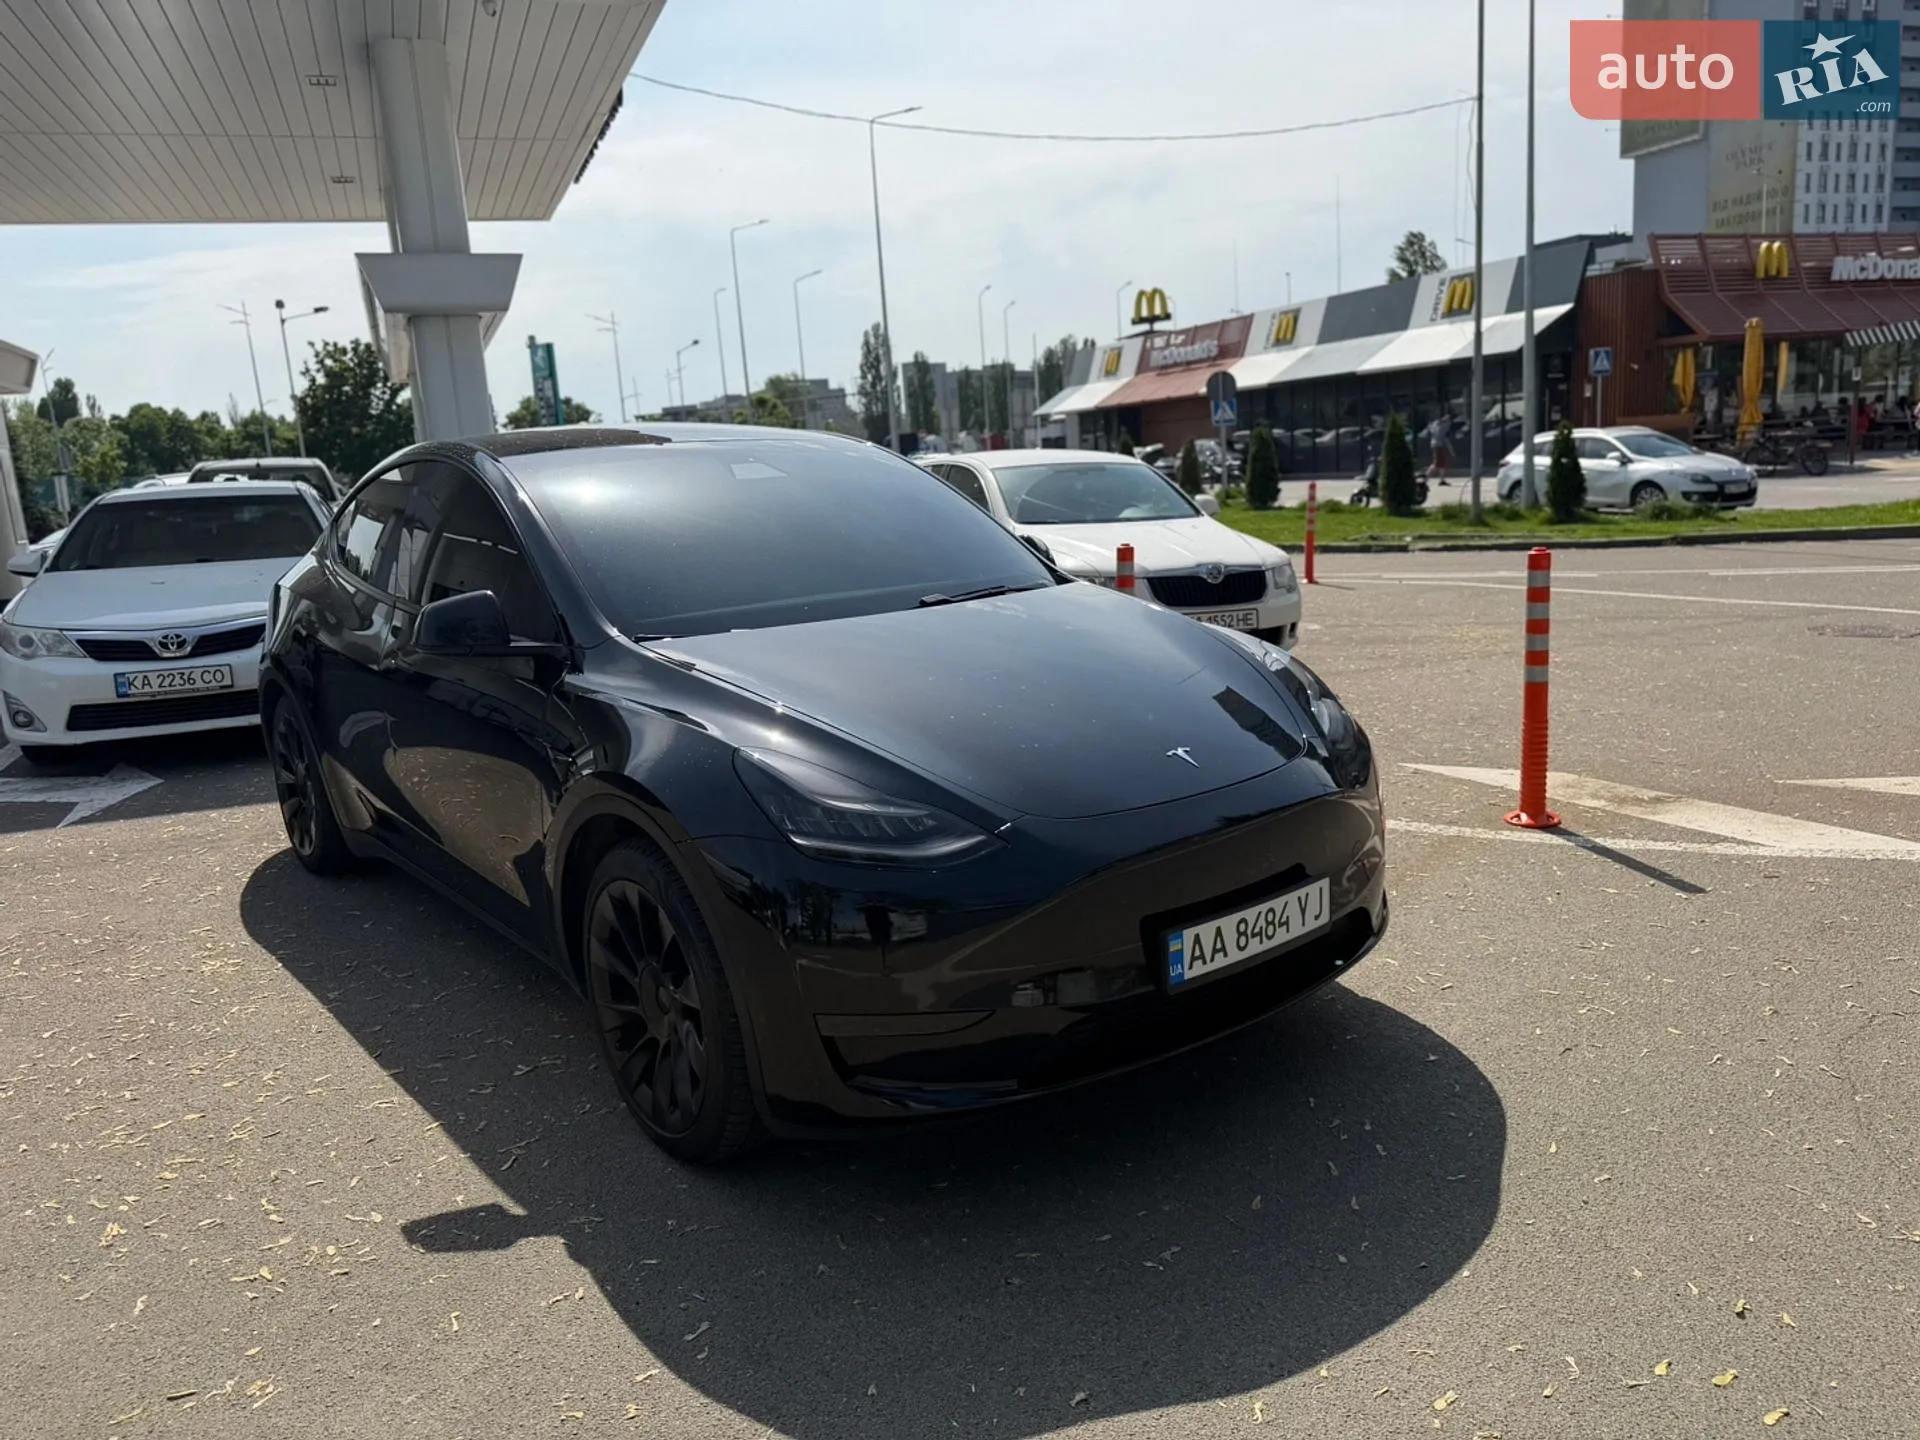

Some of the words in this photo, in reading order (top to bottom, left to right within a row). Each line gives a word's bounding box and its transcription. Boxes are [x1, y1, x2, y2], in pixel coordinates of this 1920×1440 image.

[1236, 611, 1254, 627] HE
[126, 674, 153, 691] KA
[156, 671, 197, 688] 2236
[200, 668, 225, 685] CO
[1188, 925, 1228, 970] AA
[1235, 901, 1290, 952] 8484
[1297, 887, 1323, 927] YJ
[1170, 963, 1183, 977] UA
